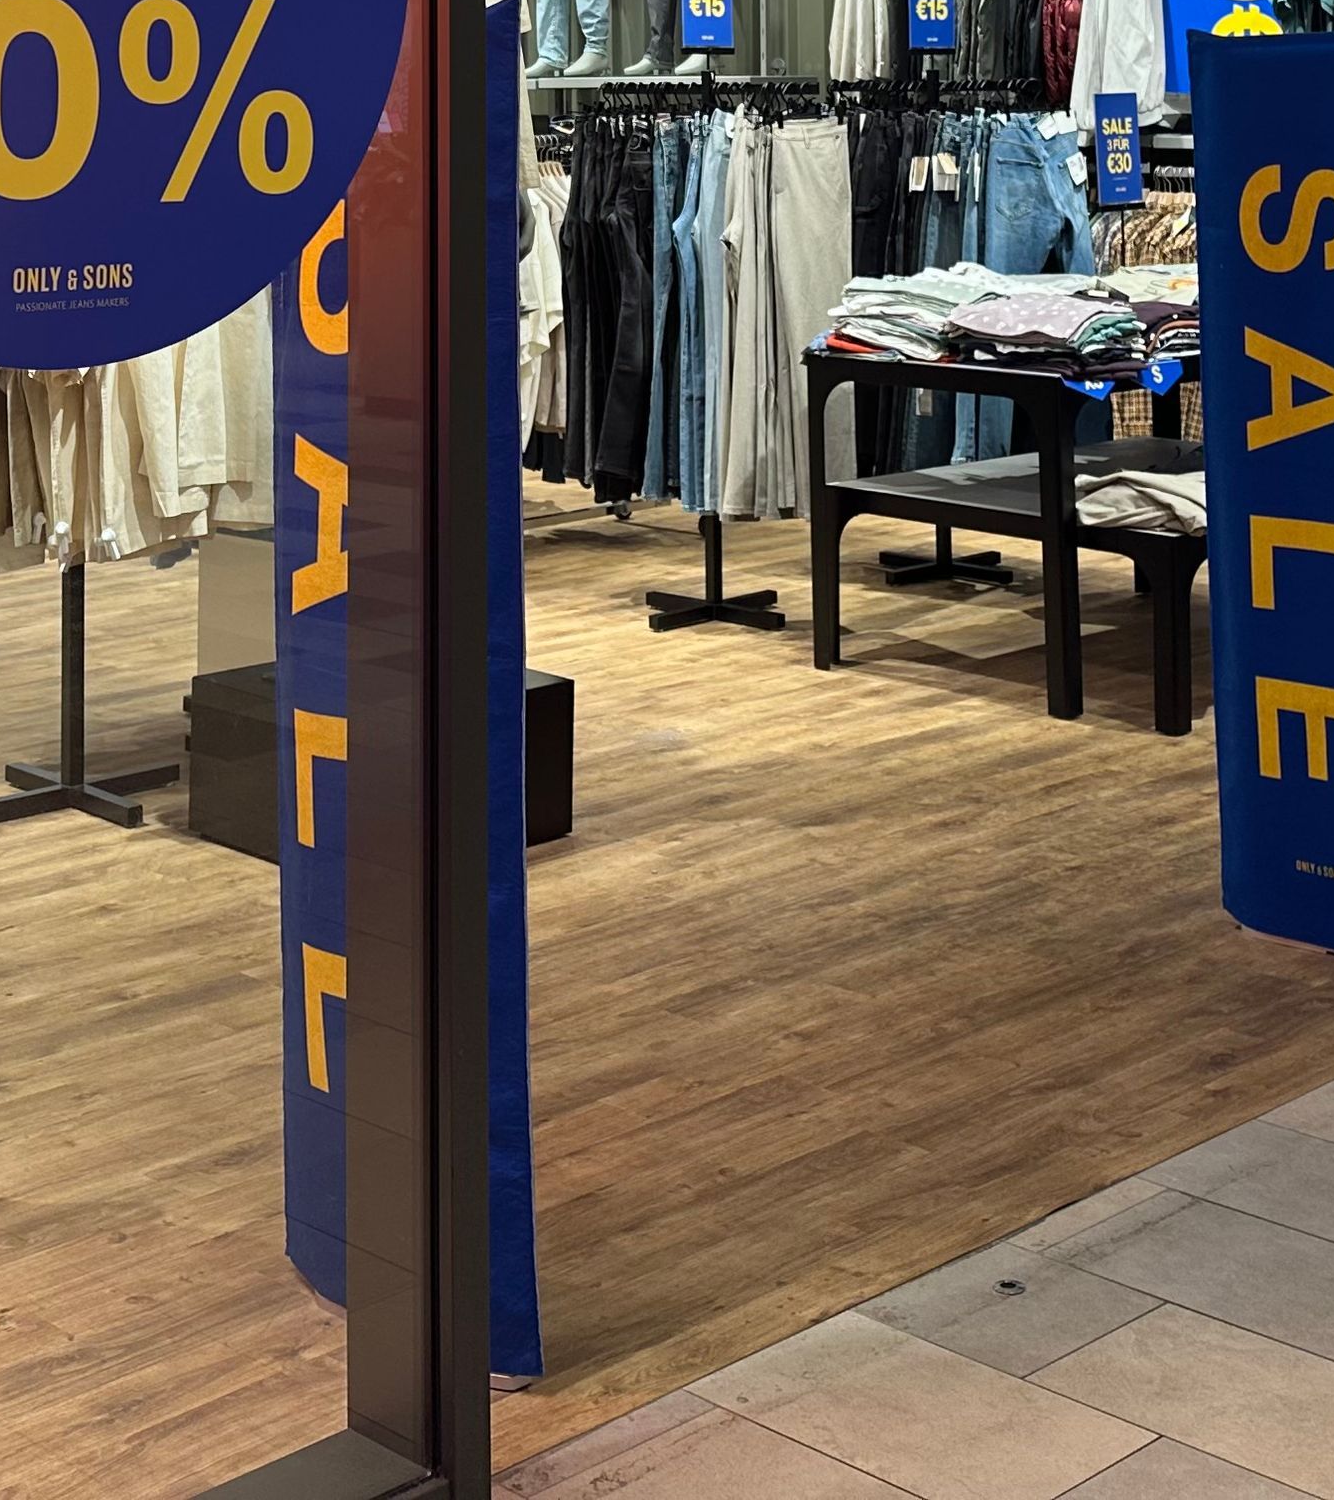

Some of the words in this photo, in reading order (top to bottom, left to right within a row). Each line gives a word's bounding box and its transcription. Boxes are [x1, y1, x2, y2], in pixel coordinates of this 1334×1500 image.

[1102, 117, 1133, 135] SALE
[1107, 139, 1113, 151] 3
[1107, 152, 1132, 174] €30
[13, 266, 62, 294] ONLY
[67, 269, 78, 291] &
[83, 263, 133, 290] SONS
[16, 300, 67, 313] PASSIONATE
[69, 298, 95, 310] JEANS
[96, 296, 130, 308] MAKERS
